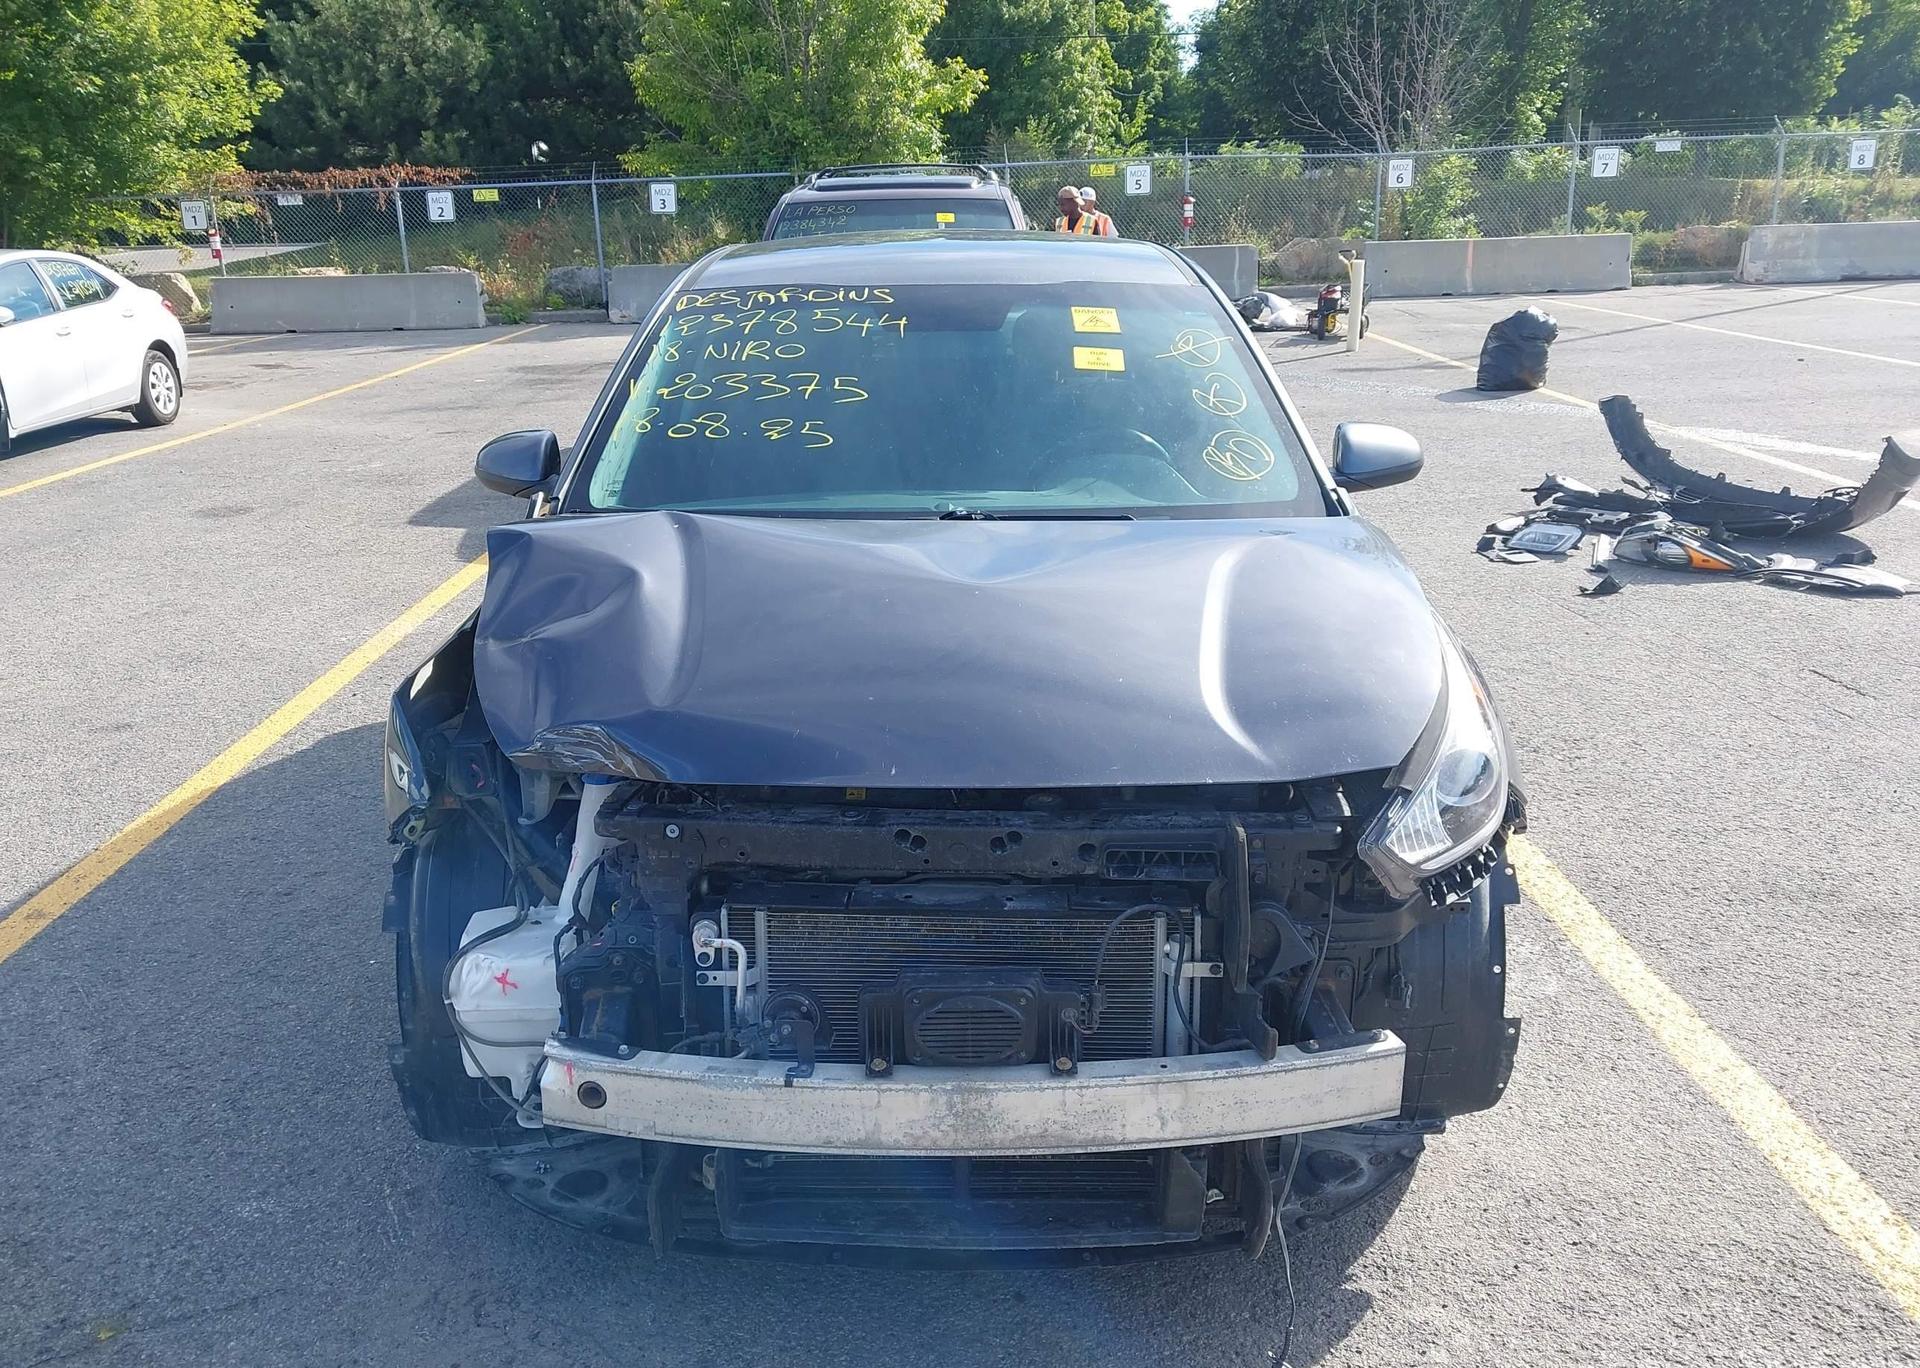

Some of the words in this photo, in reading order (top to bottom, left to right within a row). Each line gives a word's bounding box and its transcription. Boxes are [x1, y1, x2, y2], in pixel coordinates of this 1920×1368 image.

[1597, 152, 1615, 161] MDZ
[1857, 154, 1866, 165] 8
[1392, 163, 1409, 171] MDZ
[1601, 162, 1609, 174] 7
[1129, 169, 1147, 177] MDZ
[1396, 172, 1404, 184] 6
[1134, 179, 1142, 190] 5
[654, 188, 672, 196] MDZ
[431, 196, 448, 205] MDZ
[659, 198, 667, 210] 3
[184, 206, 202, 214] MDZ
[436, 206, 445, 218] 2
[785, 207, 804, 218] LA
[808, 205, 856, 216] PERSO
[191, 215, 198, 226] 1
